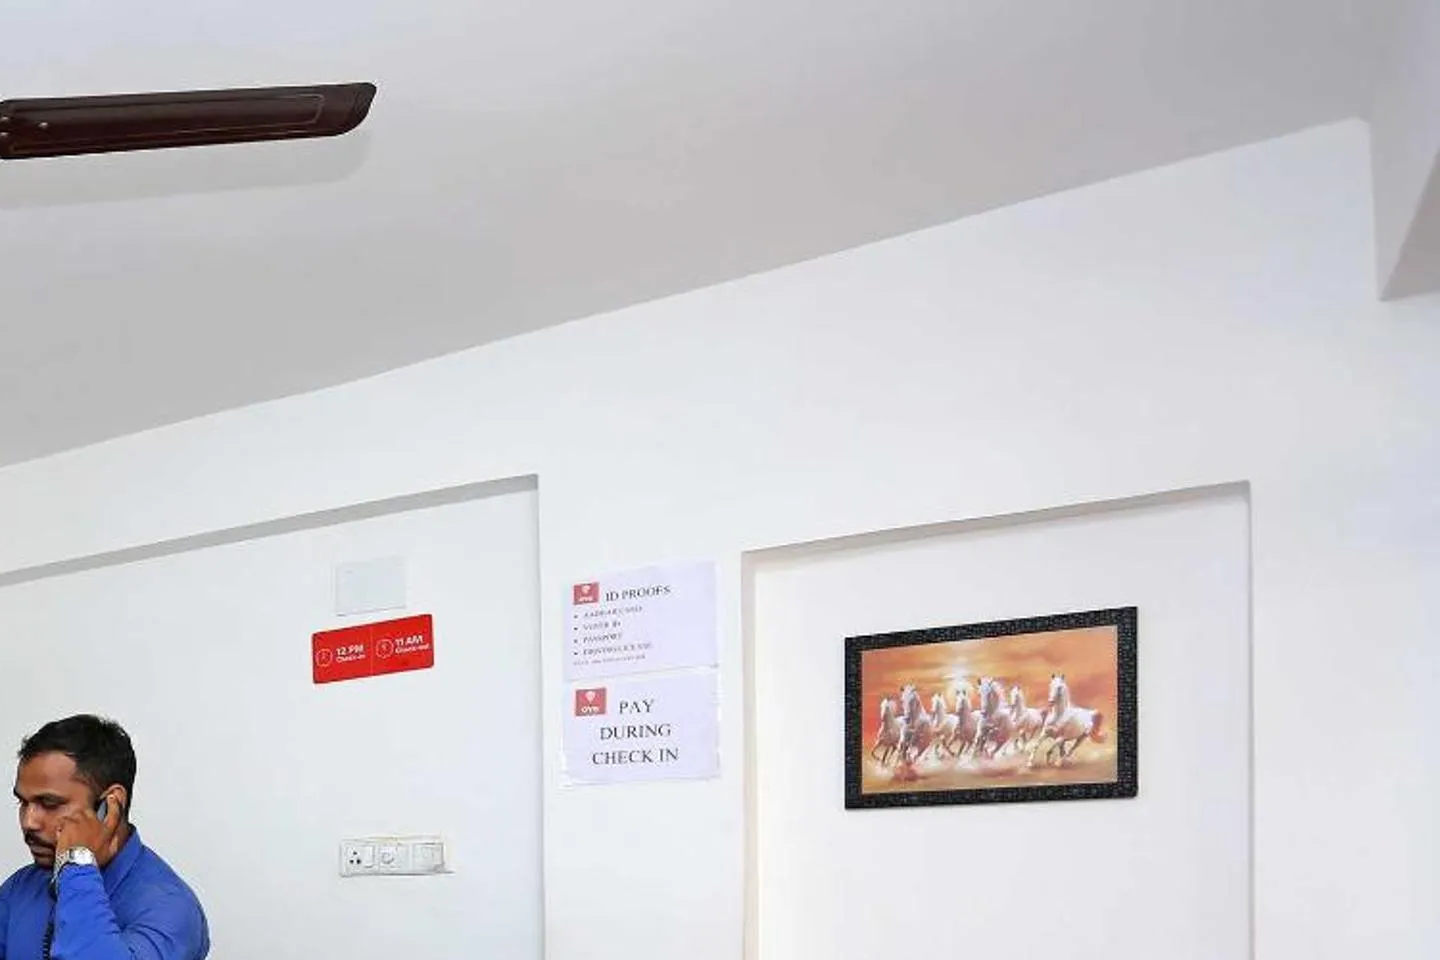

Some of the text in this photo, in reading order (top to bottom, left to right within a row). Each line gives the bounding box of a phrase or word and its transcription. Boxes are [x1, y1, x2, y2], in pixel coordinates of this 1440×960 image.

[605, 584, 672, 602] ID PROOFS
[336, 644, 364, 656] 12 PM
[619, 698, 655, 715] PAY
[599, 723, 672, 741] DURING
[591, 747, 680, 765] CHECK IN
